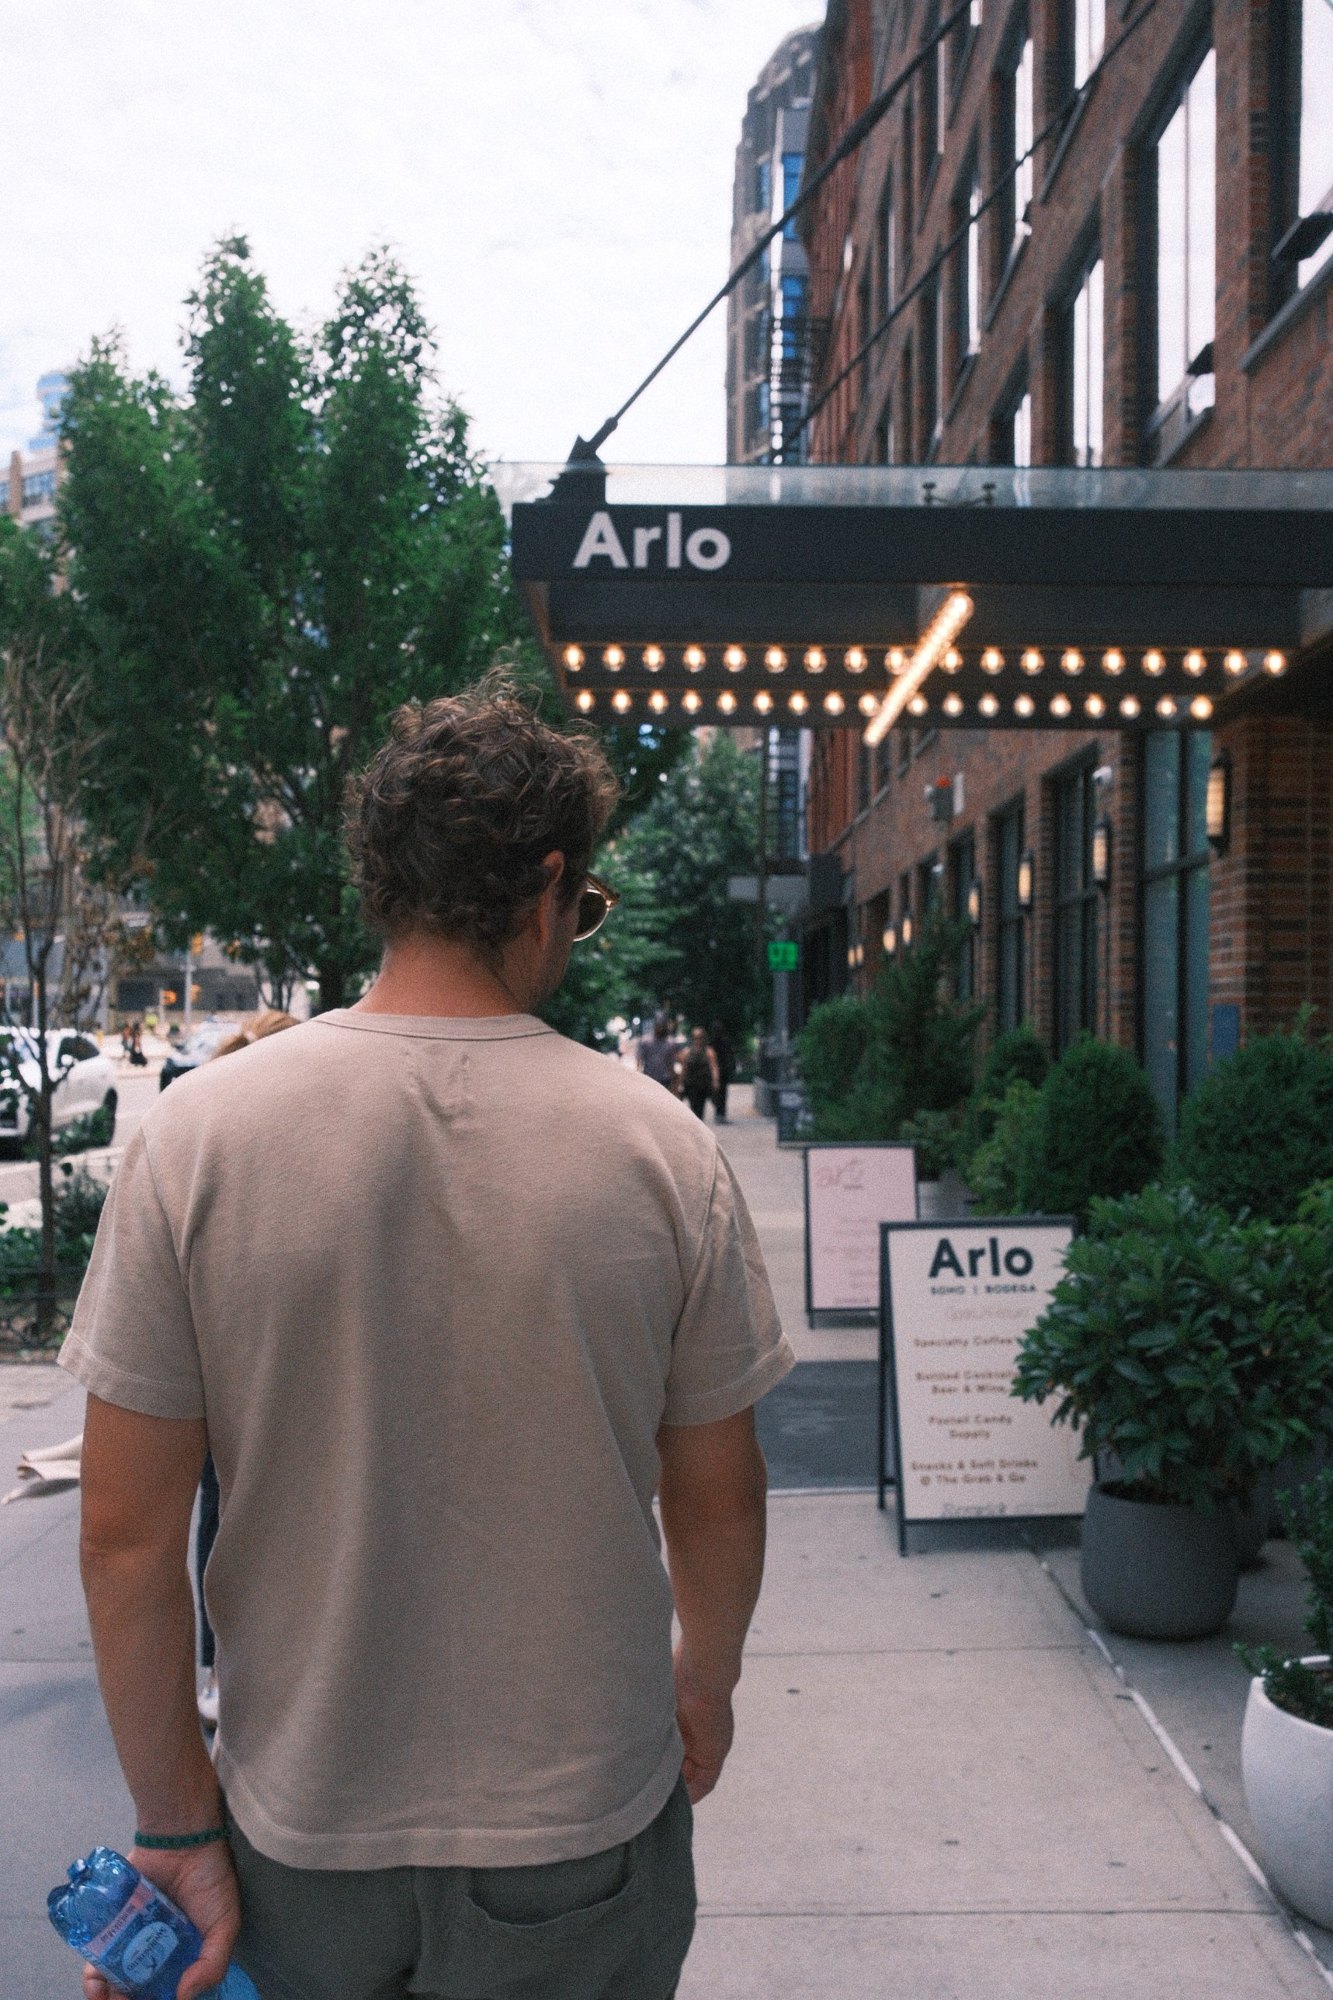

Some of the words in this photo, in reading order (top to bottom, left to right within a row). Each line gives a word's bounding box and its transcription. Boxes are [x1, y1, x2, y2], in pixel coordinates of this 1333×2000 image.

[573, 511, 731, 571] Arlo
[928, 1237, 1034, 1279] Arlo
[985, 1284, 1036, 1294] BODEGA
[973, 1336, 1013, 1346] Coffee
